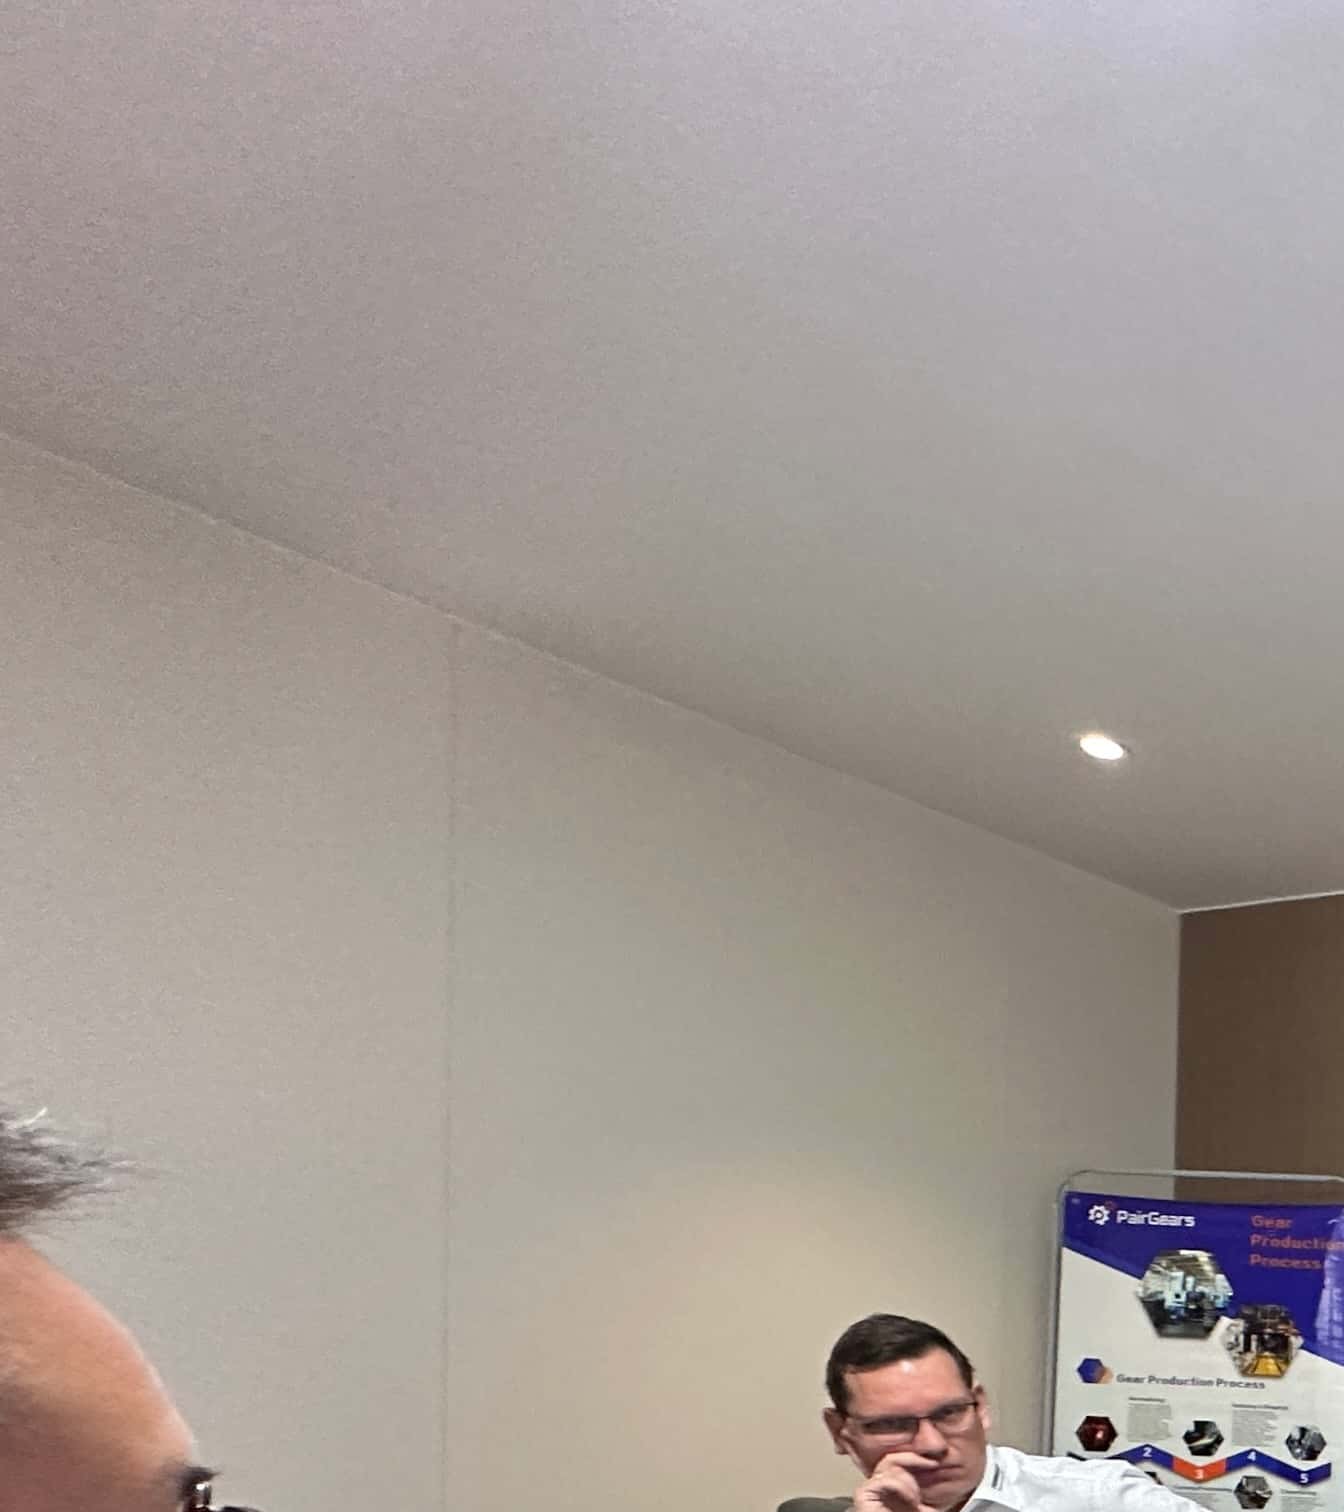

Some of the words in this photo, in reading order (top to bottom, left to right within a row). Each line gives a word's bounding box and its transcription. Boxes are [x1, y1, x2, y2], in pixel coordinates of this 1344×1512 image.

[1116, 1209, 1196, 1227] PairGears
[1251, 1215, 1293, 1229] Gear
[1250, 1253, 1323, 1270] Process
[1116, 1373, 1146, 1384] Gear
[1147, 1375, 1214, 1388] Production
[1216, 1378, 1266, 1390] Process
[1143, 1447, 1152, 1458] 2
[1248, 1451, 1256, 1462] 4
[1300, 1473, 1309, 1485] 5
